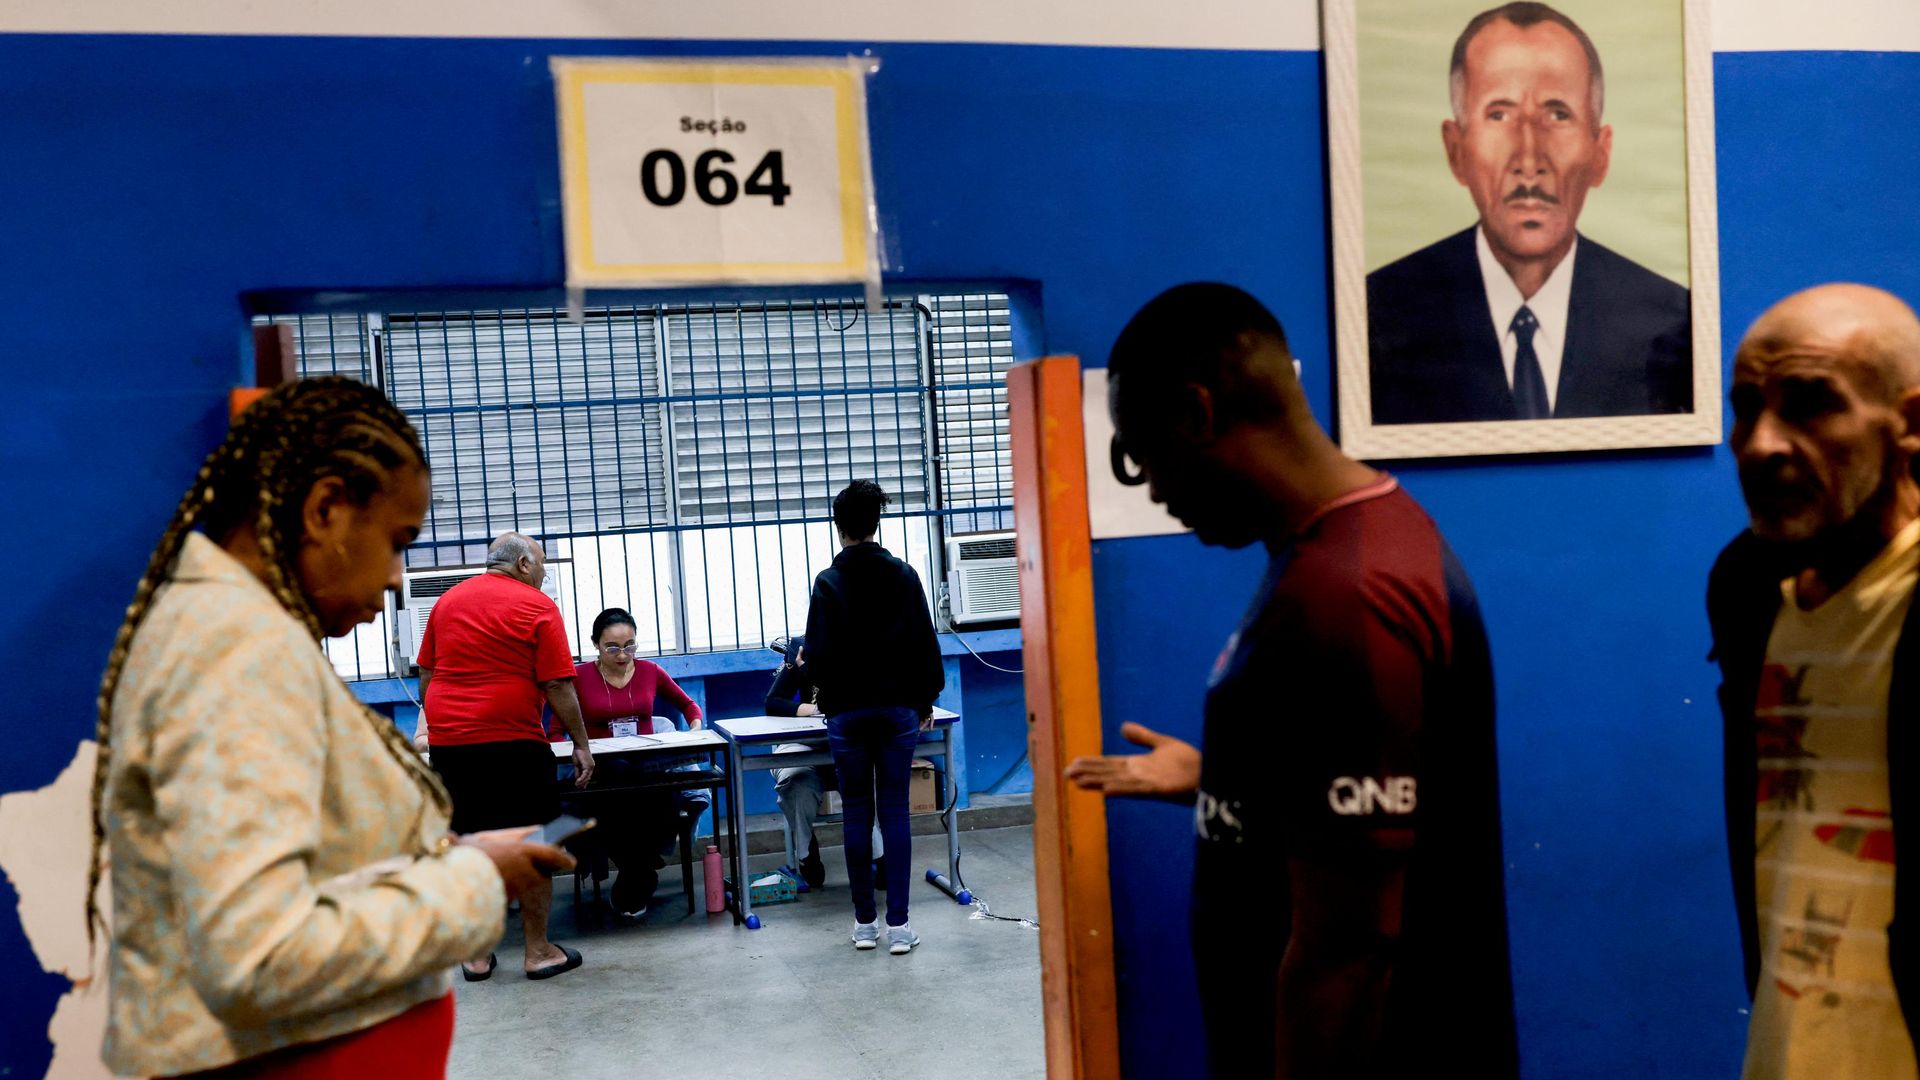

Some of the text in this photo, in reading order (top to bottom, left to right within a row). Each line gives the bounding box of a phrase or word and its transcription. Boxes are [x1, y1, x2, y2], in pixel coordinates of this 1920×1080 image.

[680, 117, 746, 135] Seção
[641, 148, 791, 207] 064
[1328, 776, 1417, 815] QNB
